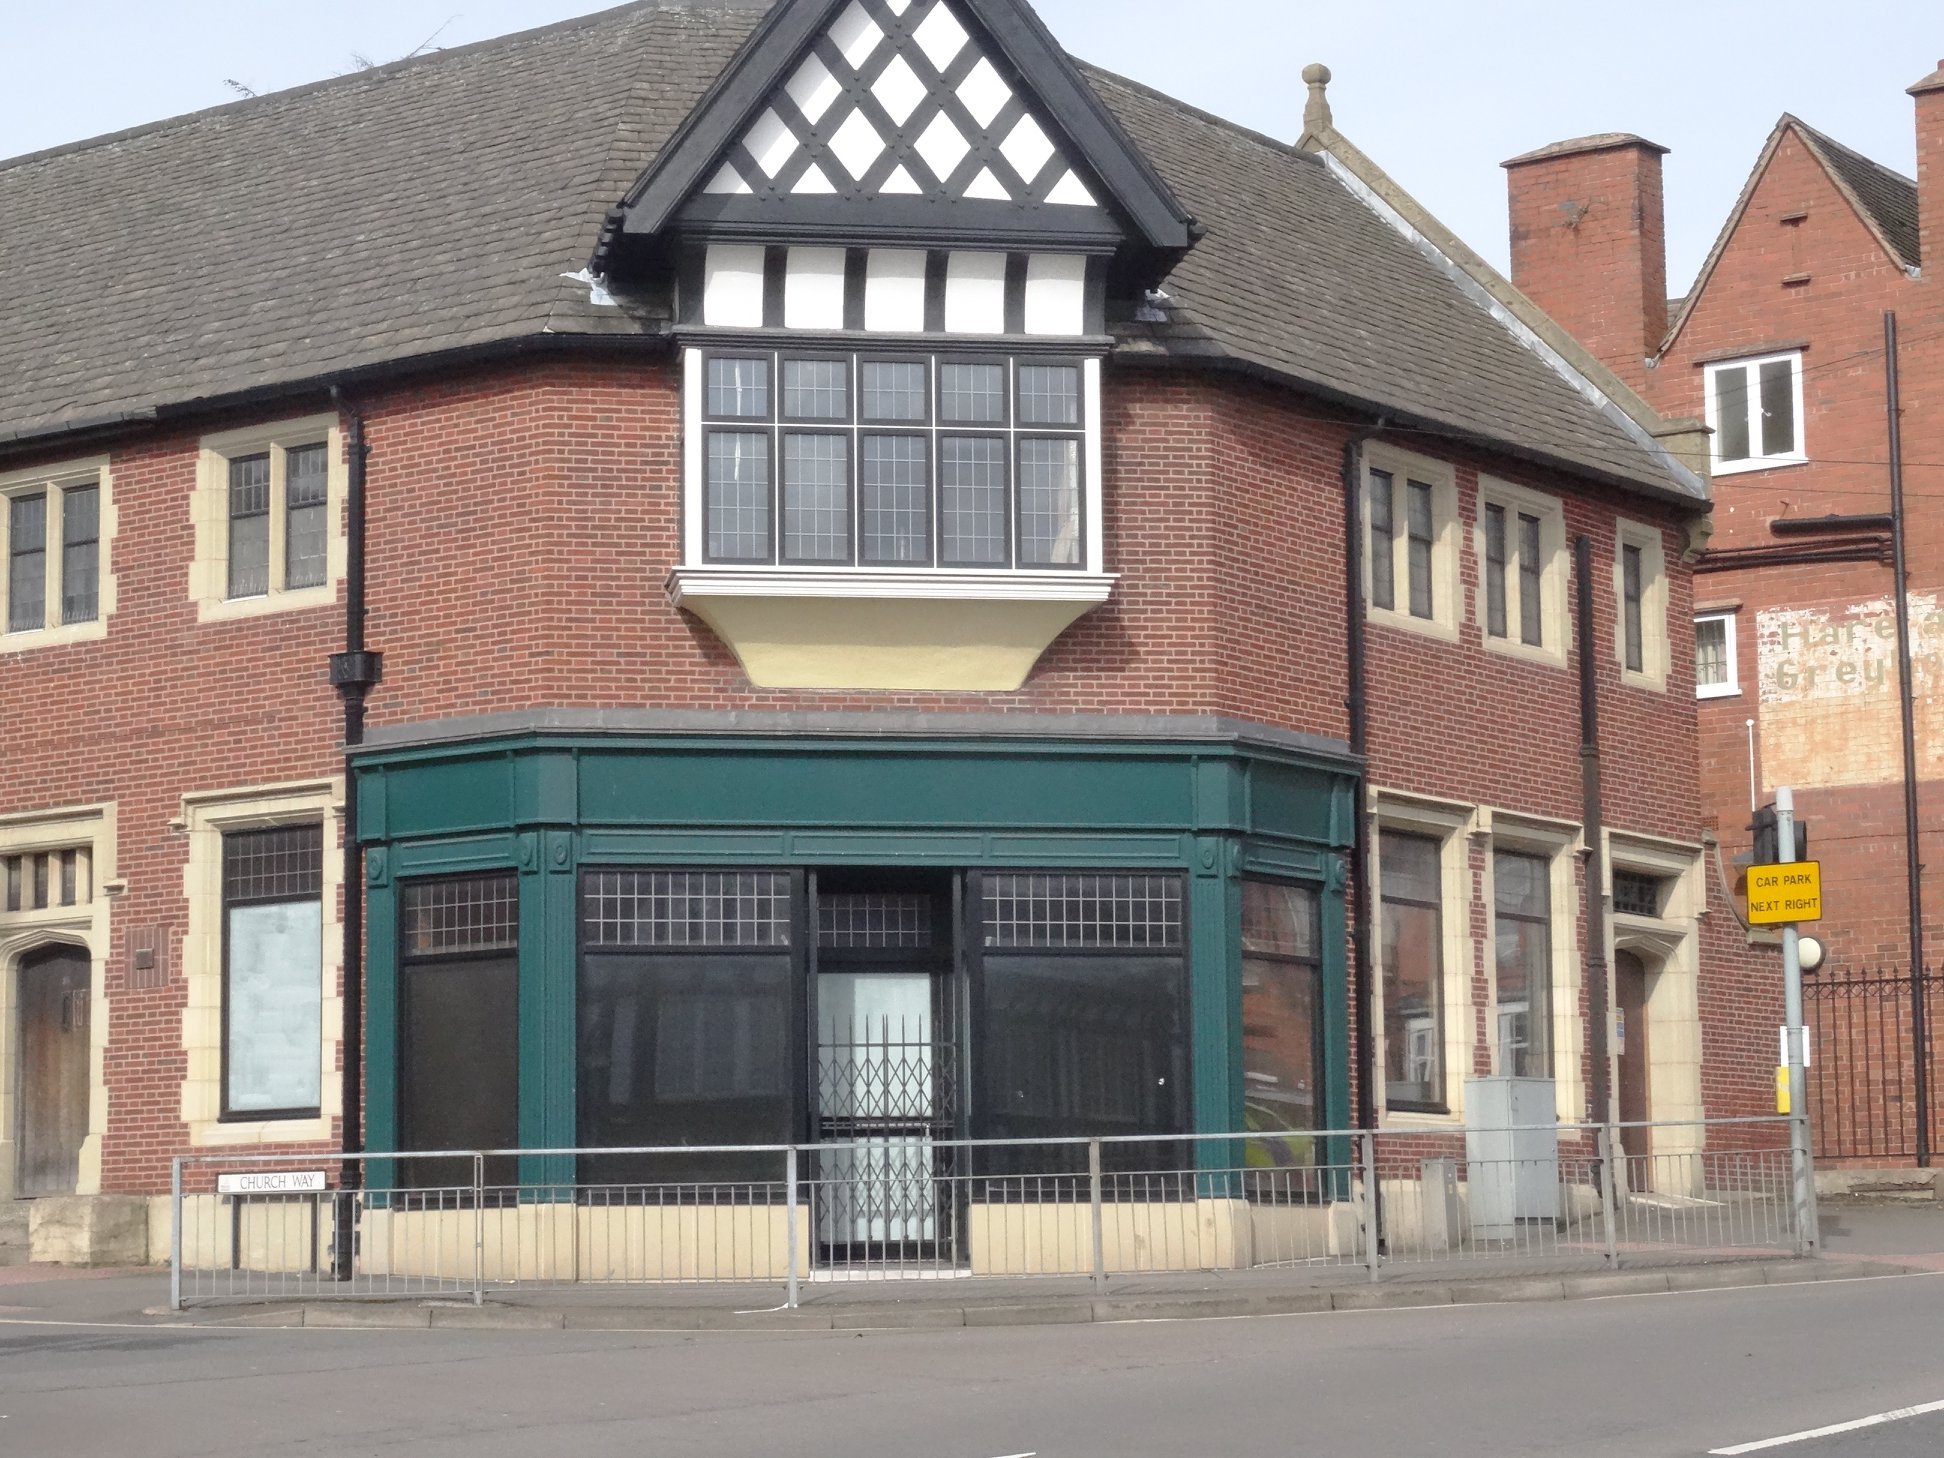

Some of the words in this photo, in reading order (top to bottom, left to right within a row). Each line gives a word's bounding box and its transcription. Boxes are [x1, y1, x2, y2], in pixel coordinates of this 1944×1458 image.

[1781, 616, 1896, 650] Hare
[1756, 876, 1779, 888] CAR
[1783, 874, 1812, 886] PARK
[1751, 900, 1780, 912] NEXT
[1785, 898, 1818, 910] RIGHT
[240, 1175, 286, 1190] CHURCH
[292, 1174, 315, 1188] WAY
